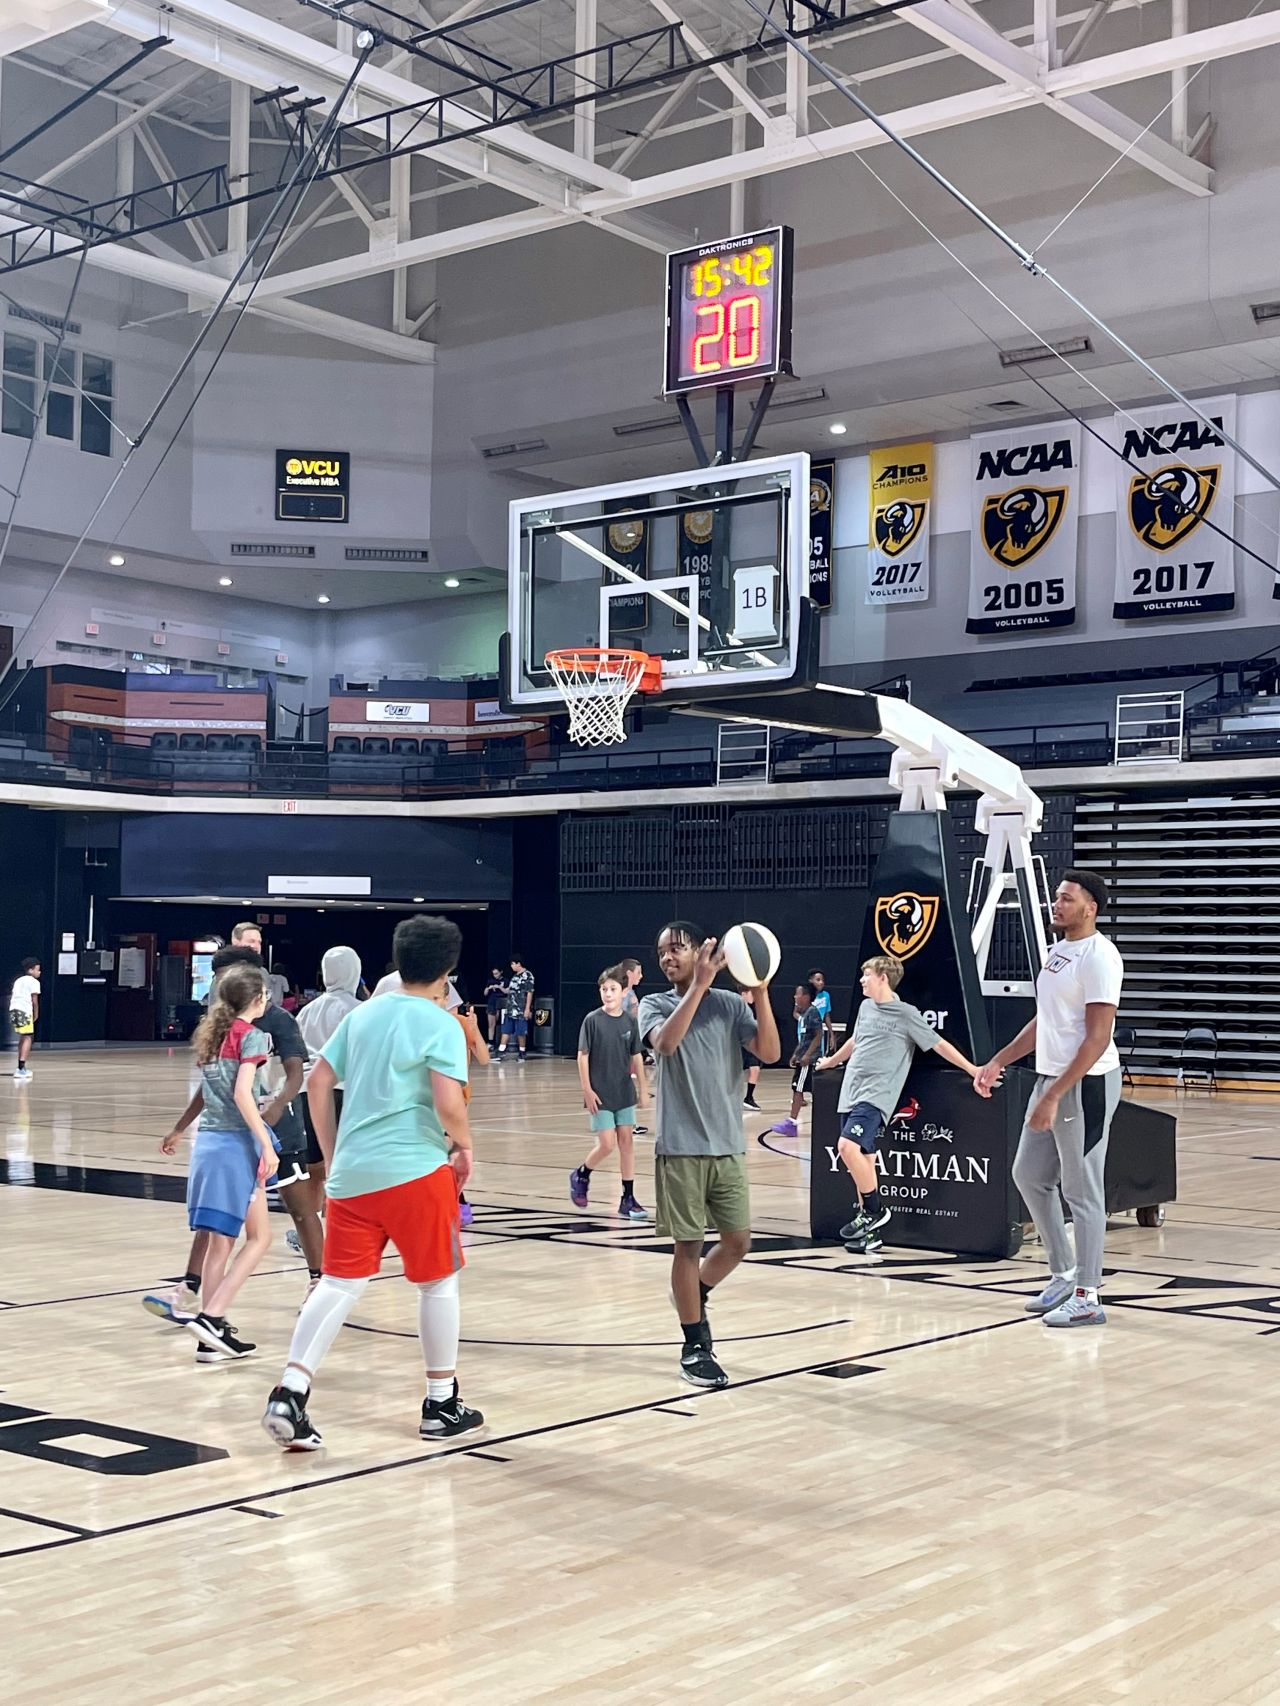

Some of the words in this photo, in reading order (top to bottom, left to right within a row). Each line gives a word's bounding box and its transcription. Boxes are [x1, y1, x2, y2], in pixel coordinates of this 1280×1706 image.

[699, 237, 754, 257] DAKTRONICS
[692, 245, 773, 298] 15:42
[693, 296, 761, 373] 20
[1121, 416, 1225, 460] NCAA
[301, 460, 340, 476] VCU
[975, 439, 1073, 481] NCAA
[876, 463, 926, 482] A10
[320, 477, 341, 487] MBA
[872, 475, 929, 490] CHAMPIONS
[871, 562, 923, 586] 2017
[1133, 561, 1215, 596] 2017
[742, 587, 767, 609] 1B
[870, 585, 925, 597] VOLLEYBALL
[984, 578, 1064, 612] 2005
[1143, 599, 1202, 611] VOLLEYBALL
[995, 616, 1050, 627] VOLLEYBALL
[384, 704, 411, 716] VCU
[283, 801, 296, 812] EXIT
[892, 1130, 916, 1142] THE
[824, 1146, 991, 1184] YATMAN
[879, 1185, 929, 1199] GROUP
[890, 1205, 913, 1213] FOSTER
[915, 1207, 931, 1215] REAL
[934, 1209, 959, 1218] ESTATE
